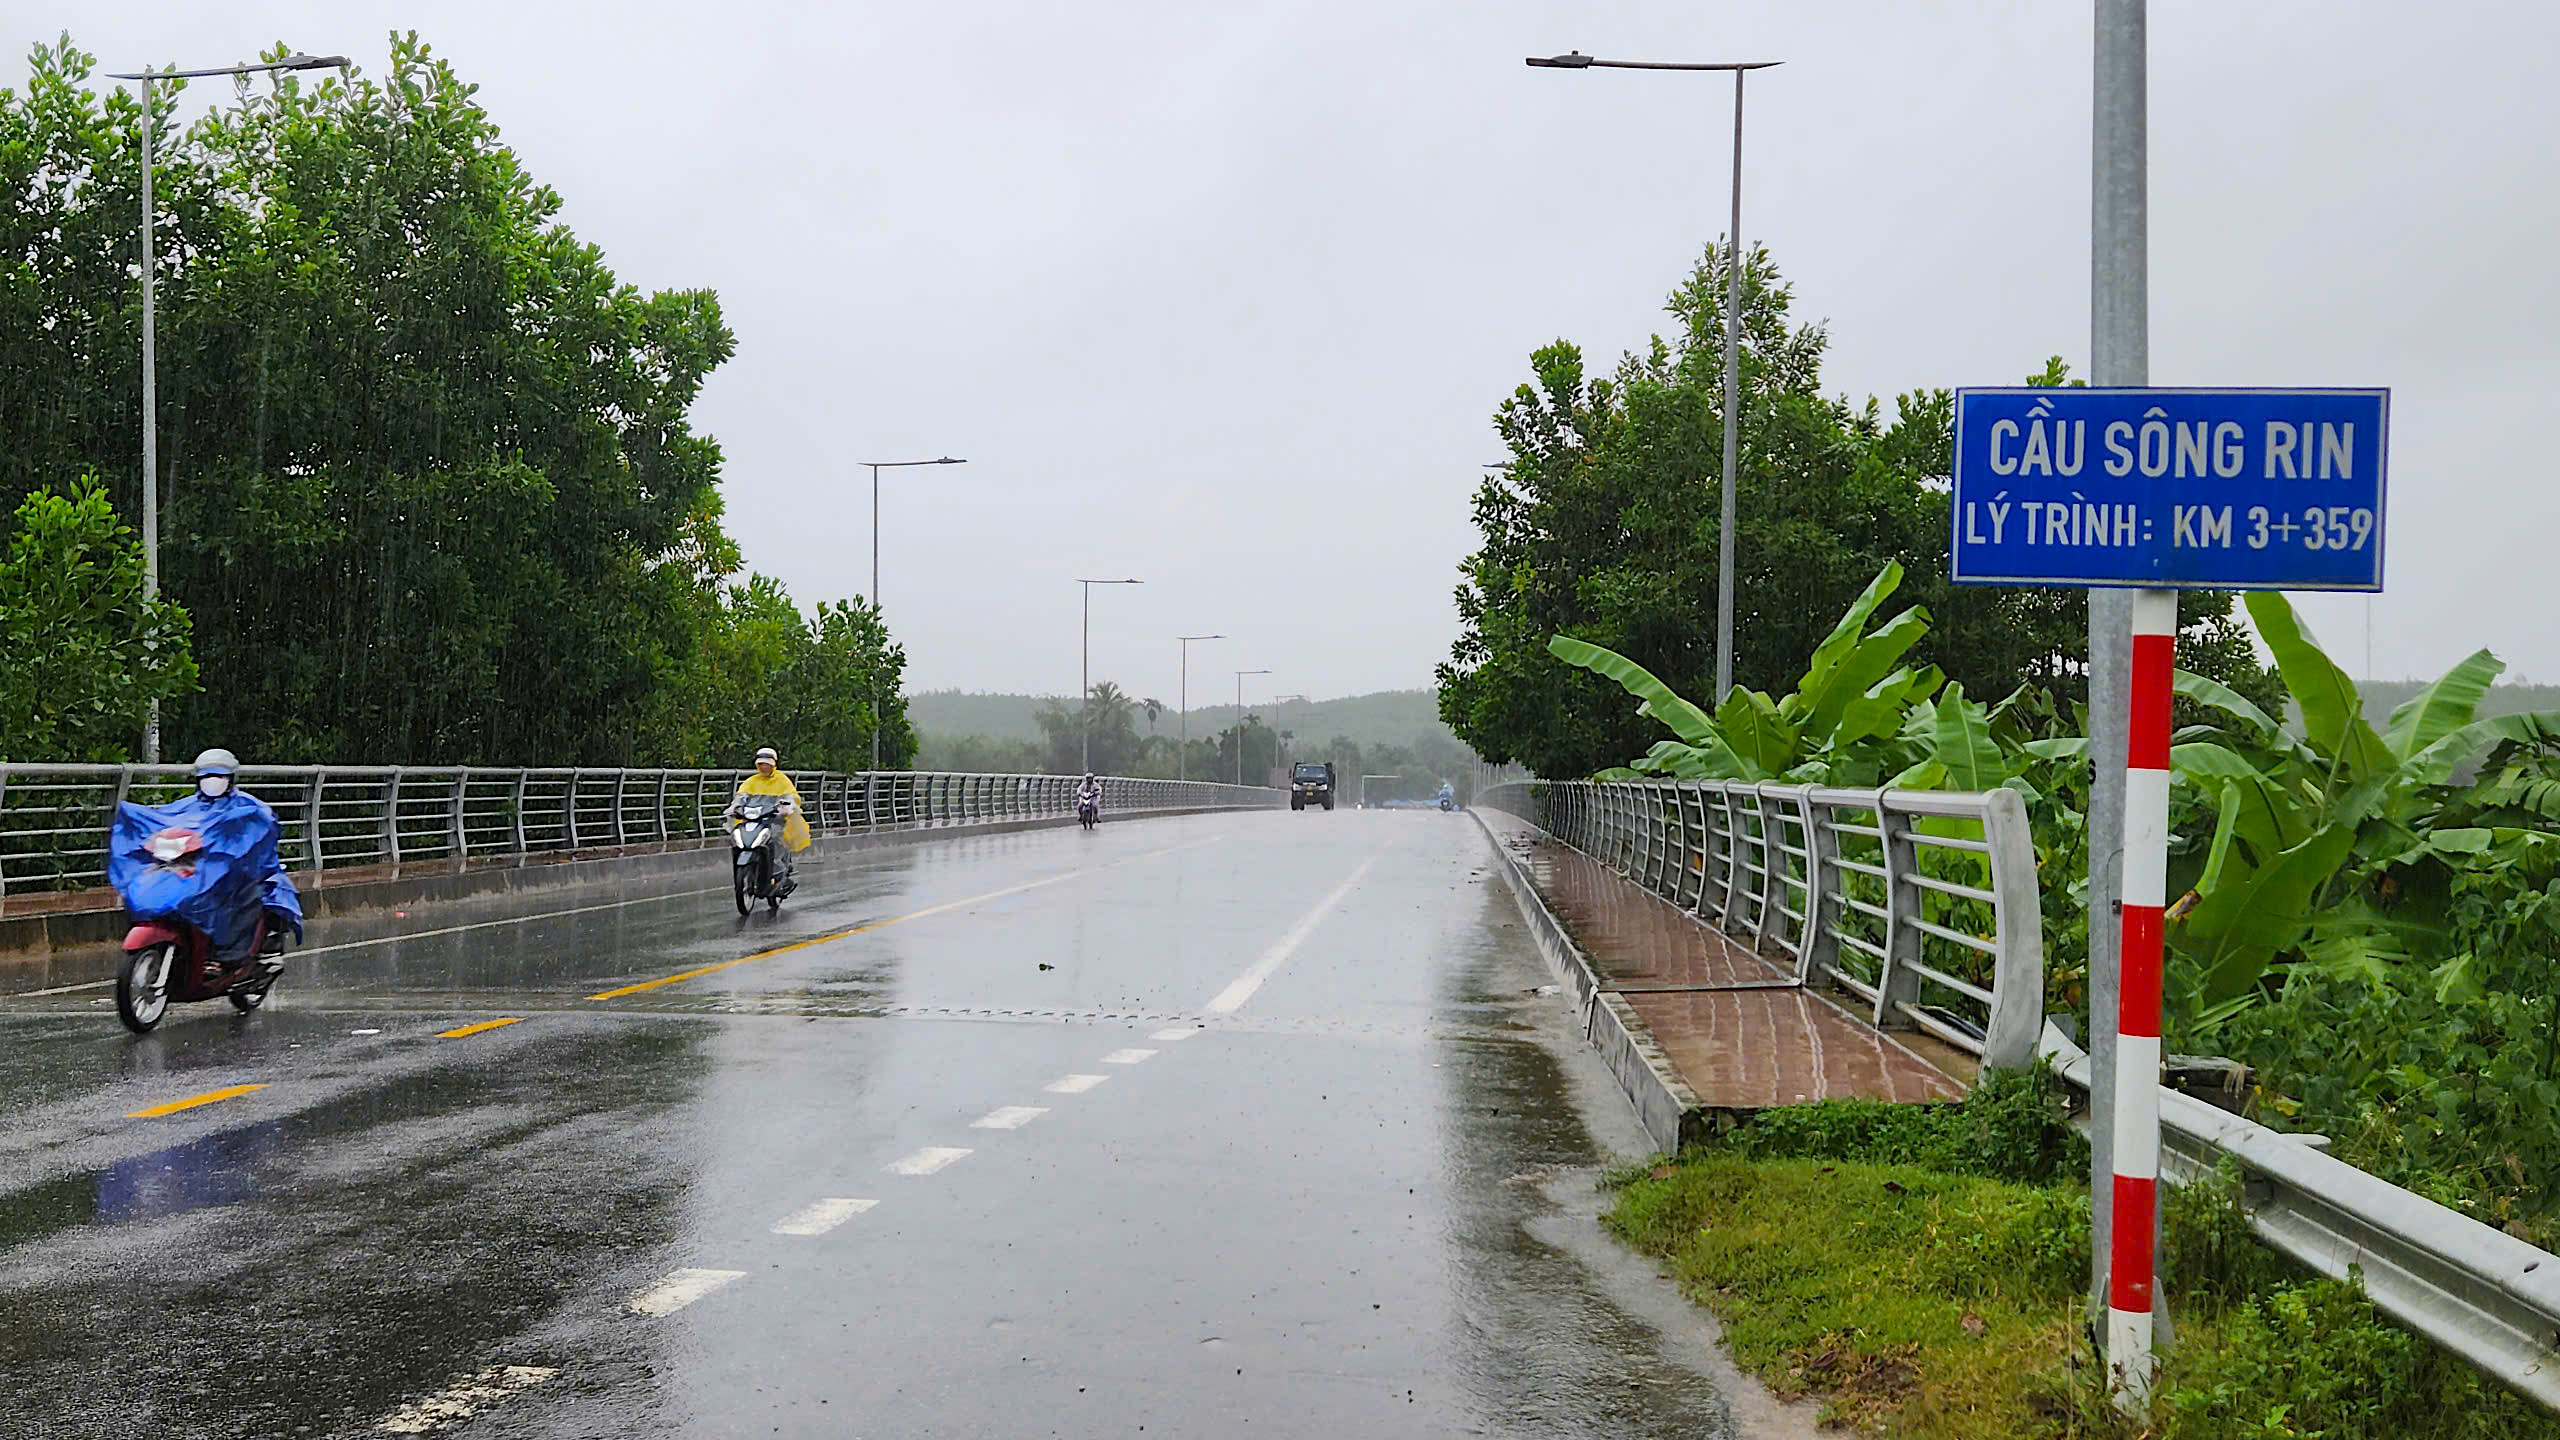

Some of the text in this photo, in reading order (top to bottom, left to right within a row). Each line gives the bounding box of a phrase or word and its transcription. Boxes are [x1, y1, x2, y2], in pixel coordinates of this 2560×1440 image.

[1990, 397, 2354, 480] CẦU SÔNG RIN
[1966, 490, 2373, 551] LÝ TRÌNH: KM 3+359
